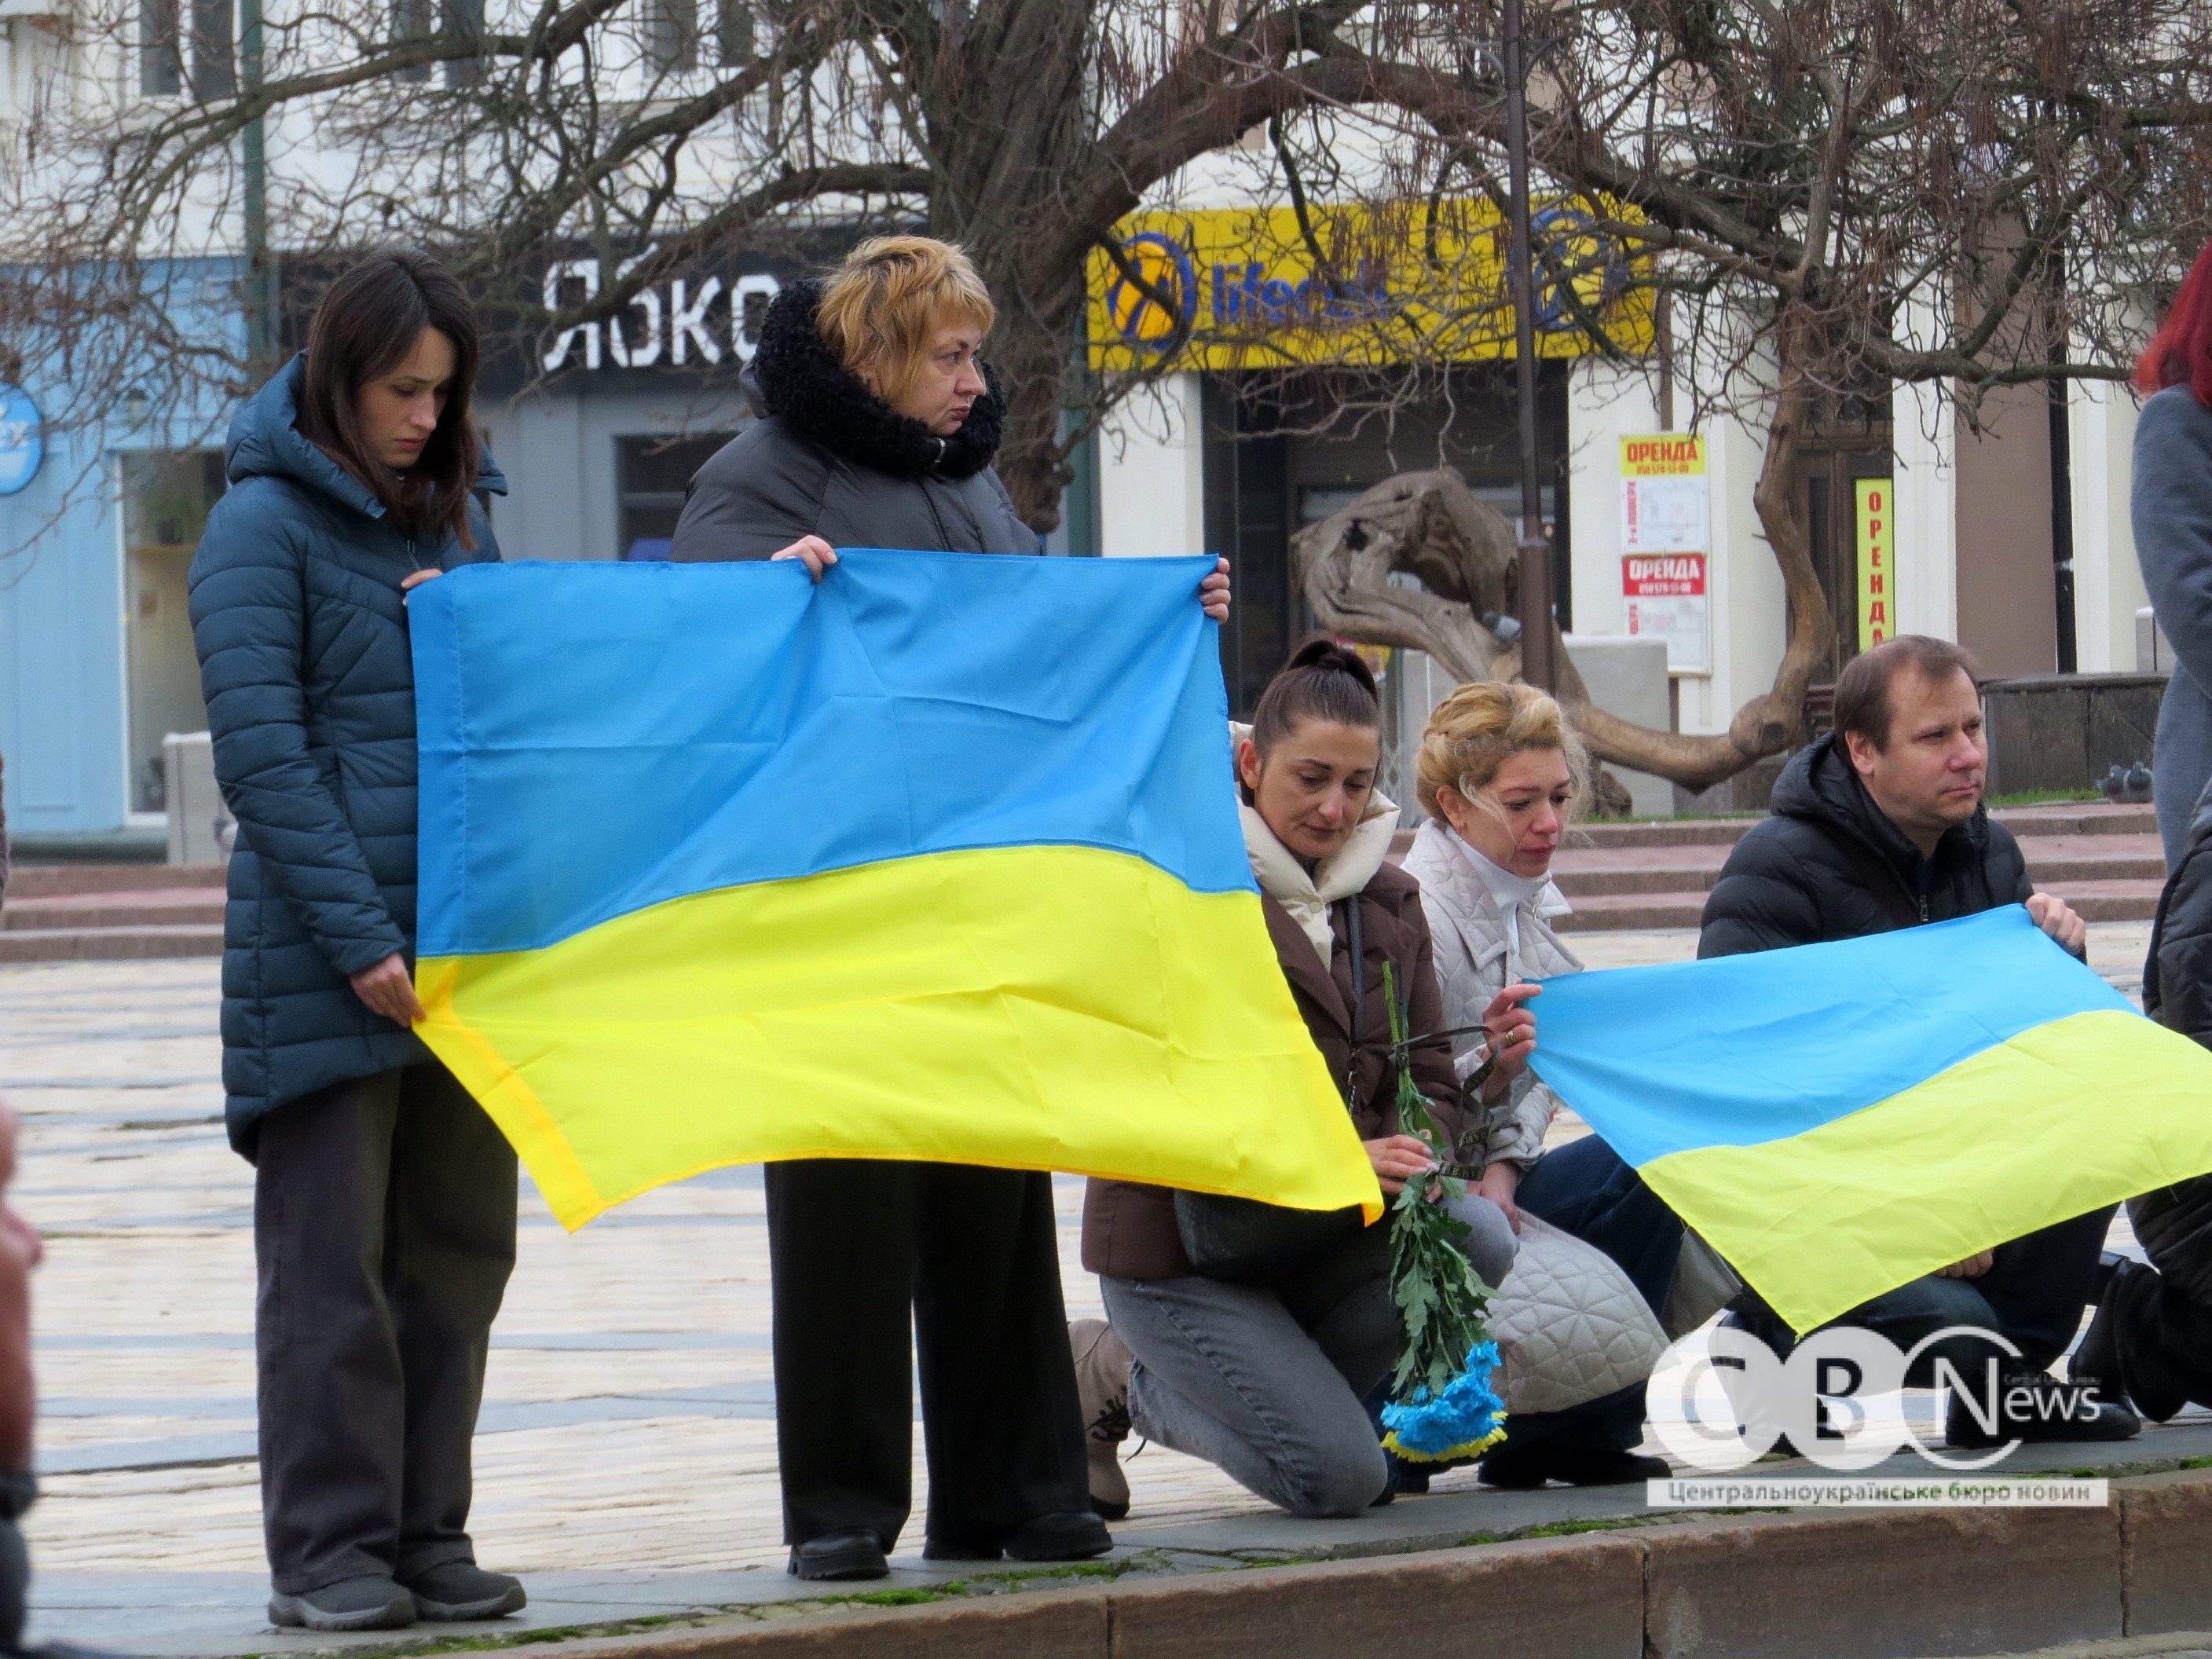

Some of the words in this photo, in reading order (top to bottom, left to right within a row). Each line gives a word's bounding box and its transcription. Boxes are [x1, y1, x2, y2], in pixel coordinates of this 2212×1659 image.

[1627, 441, 1698, 462] ОРЕНДА
[1629, 558, 1701, 580] ОРЕНДА
[1869, 491, 1885, 647] ОРЕНДА
